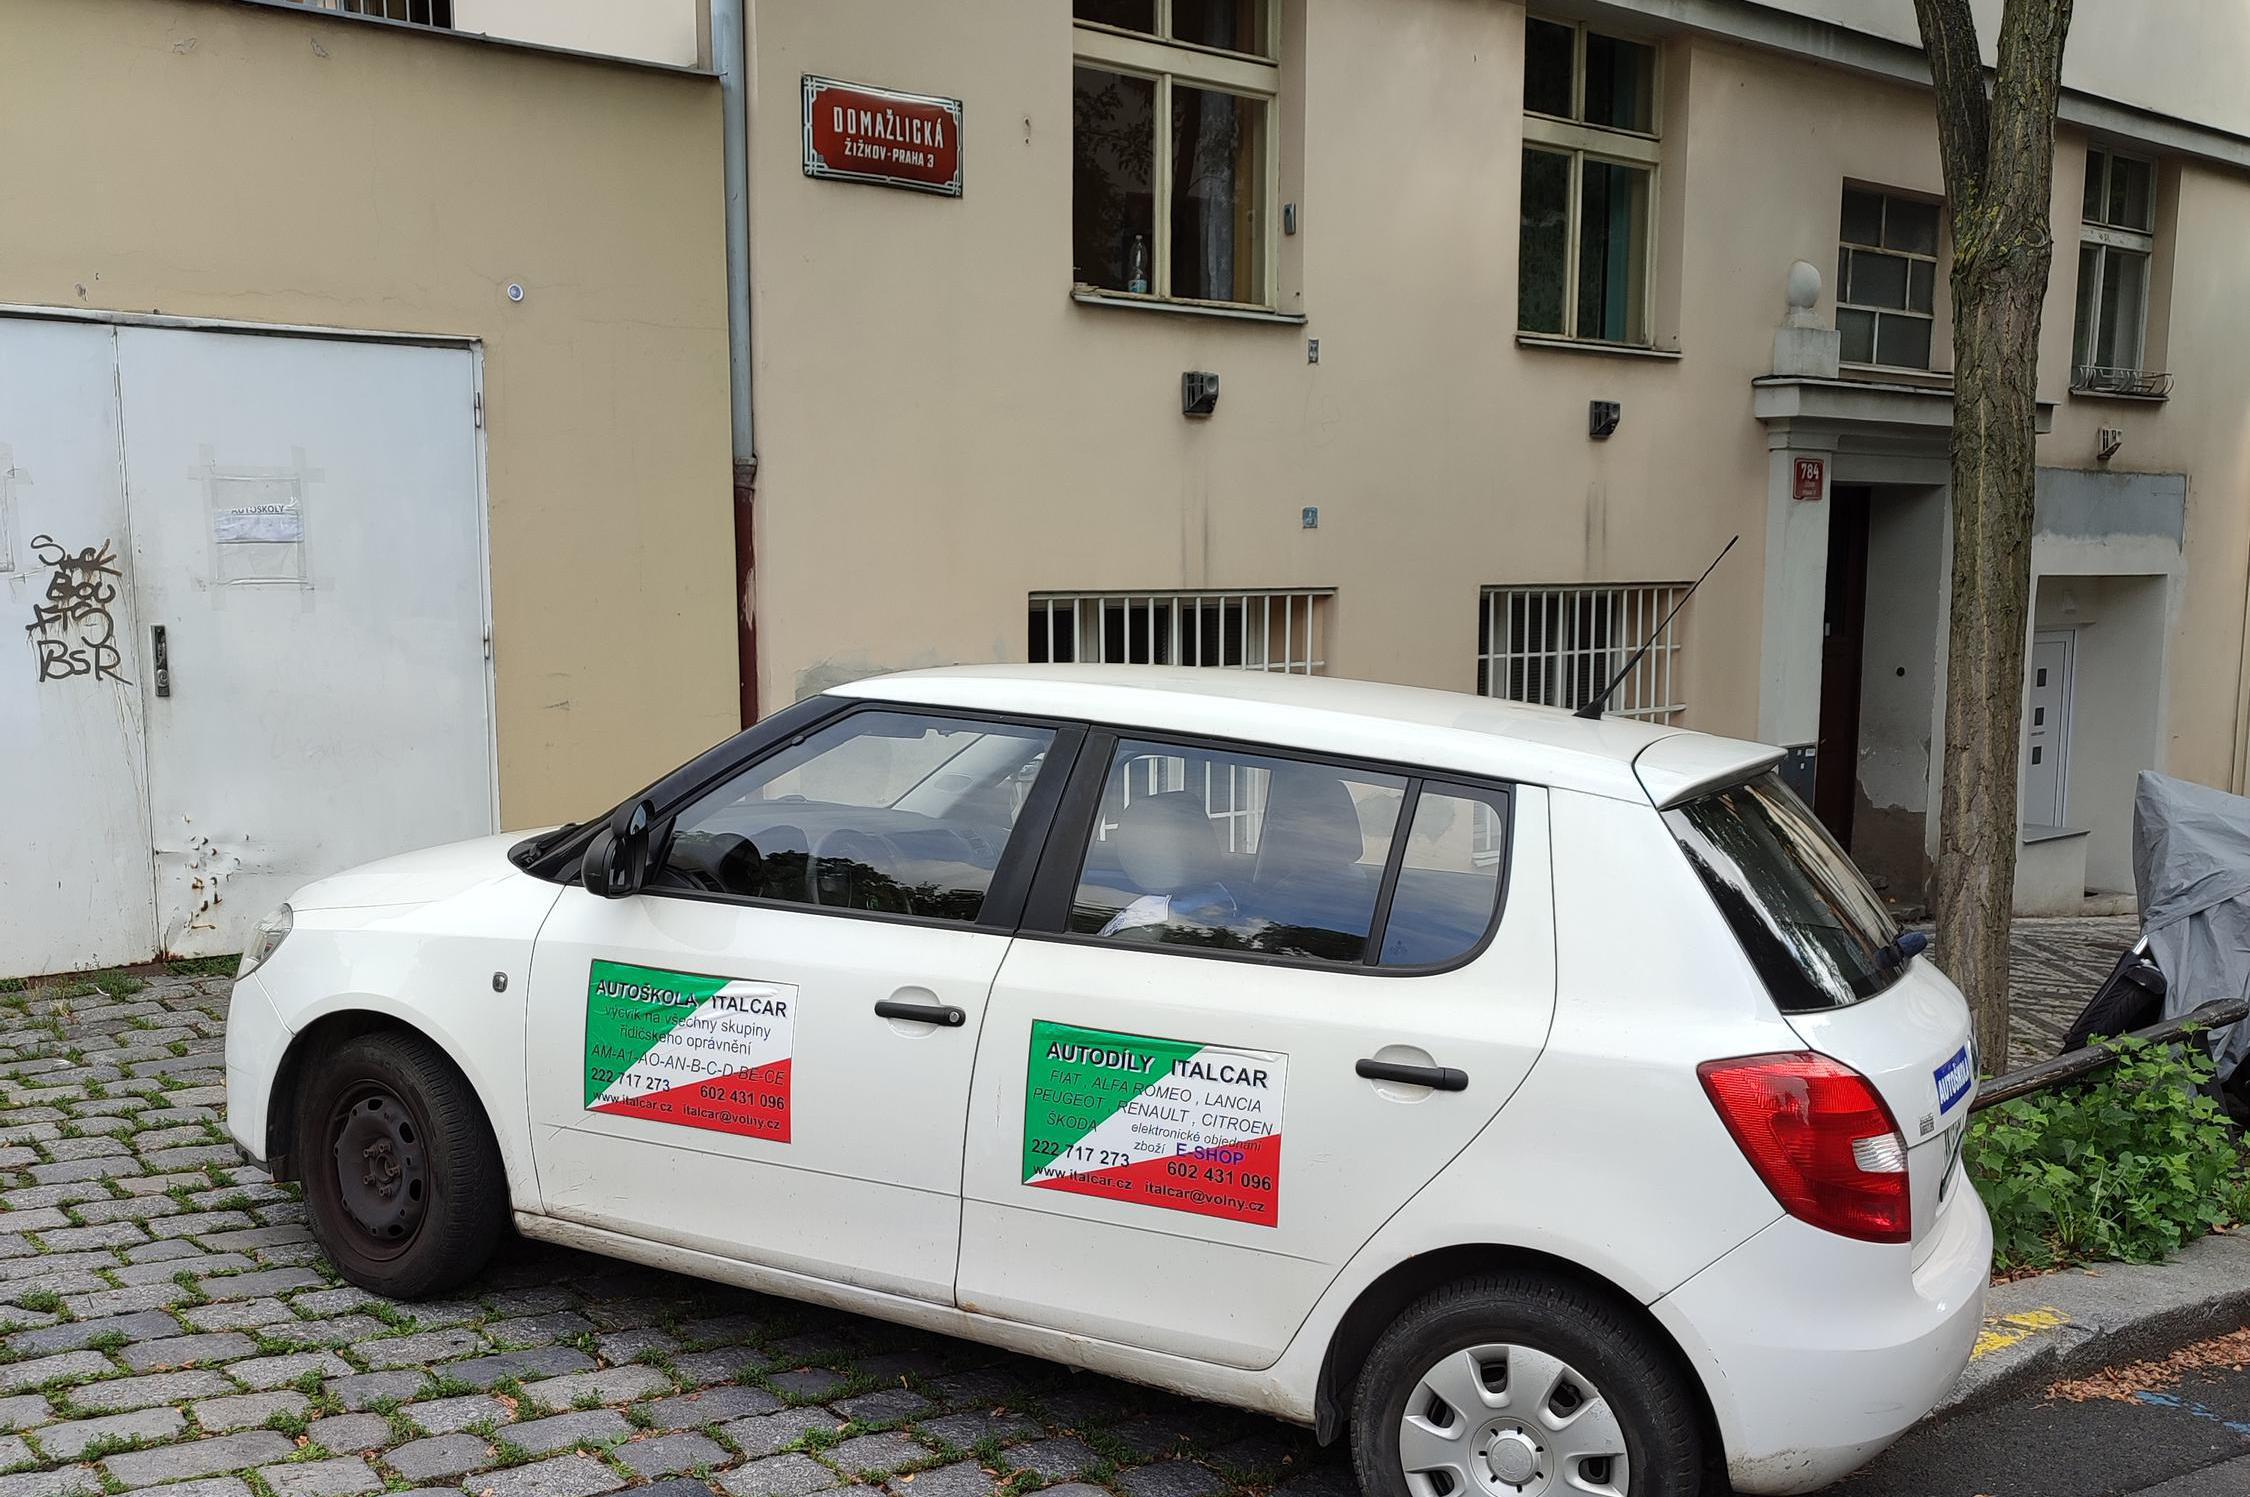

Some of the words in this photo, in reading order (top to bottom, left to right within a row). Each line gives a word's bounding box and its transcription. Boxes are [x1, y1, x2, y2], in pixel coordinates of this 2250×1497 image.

[833, 106, 944, 149] DOMAŽLICKÁ
[926, 153, 935, 168] 3
[1801, 463, 1819, 480] 784
[596, 979, 698, 1008] AUTOŠKOLA
[711, 995, 787, 1018] ITALCAR
[645, 1012, 660, 1024] na
[665, 1012, 717, 1034] všechny
[720, 1019, 771, 1041] skupiny
[686, 1036, 751, 1056] oprávnění
[1046, 1040, 1155, 1074] AUTODÍLY
[1171, 1058, 1269, 1089] ITALCAR
[591, 1067, 613, 1082] 222
[618, 1071, 641, 1088] 717
[645, 1076, 670, 1092] 273
[700, 1085, 725, 1101] 602
[730, 1090, 754, 1105] 431
[760, 1094, 785, 1110] 096
[1050, 1069, 1082, 1086] FIAT
[1092, 1077, 1129, 1094] ALFA
[1132, 1083, 1192, 1103] ROMEO
[1204, 1092, 1262, 1113] LANCIA
[593, 1091, 672, 1113] www.italcar.cz
[682, 1104, 780, 1130] italcar@volny.cz
[1033, 1088, 1104, 1110] PEUGEOT
[1117, 1100, 1190, 1123] RENAULT
[1201, 1113, 1273, 1136] CITROEN
[1047, 1110, 1097, 1132] ŠKODA
[1131, 1123, 1201, 1143] elektronické
[1133, 1140, 1166, 1154] zboží
[1176, 1142, 1245, 1165] E-SHOP
[1031, 1139, 1059, 1157] 222
[1065, 1144, 1093, 1162] 717
[1099, 1150, 1130, 1167] 273
[1167, 1161, 1197, 1179] 602
[1203, 1167, 1233, 1184] 431
[1240, 1173, 1271, 1191] 096
[1032, 1165, 1132, 1190] www.italcar.cz
[1145, 1181, 1265, 1212] italcar@volny.cz
